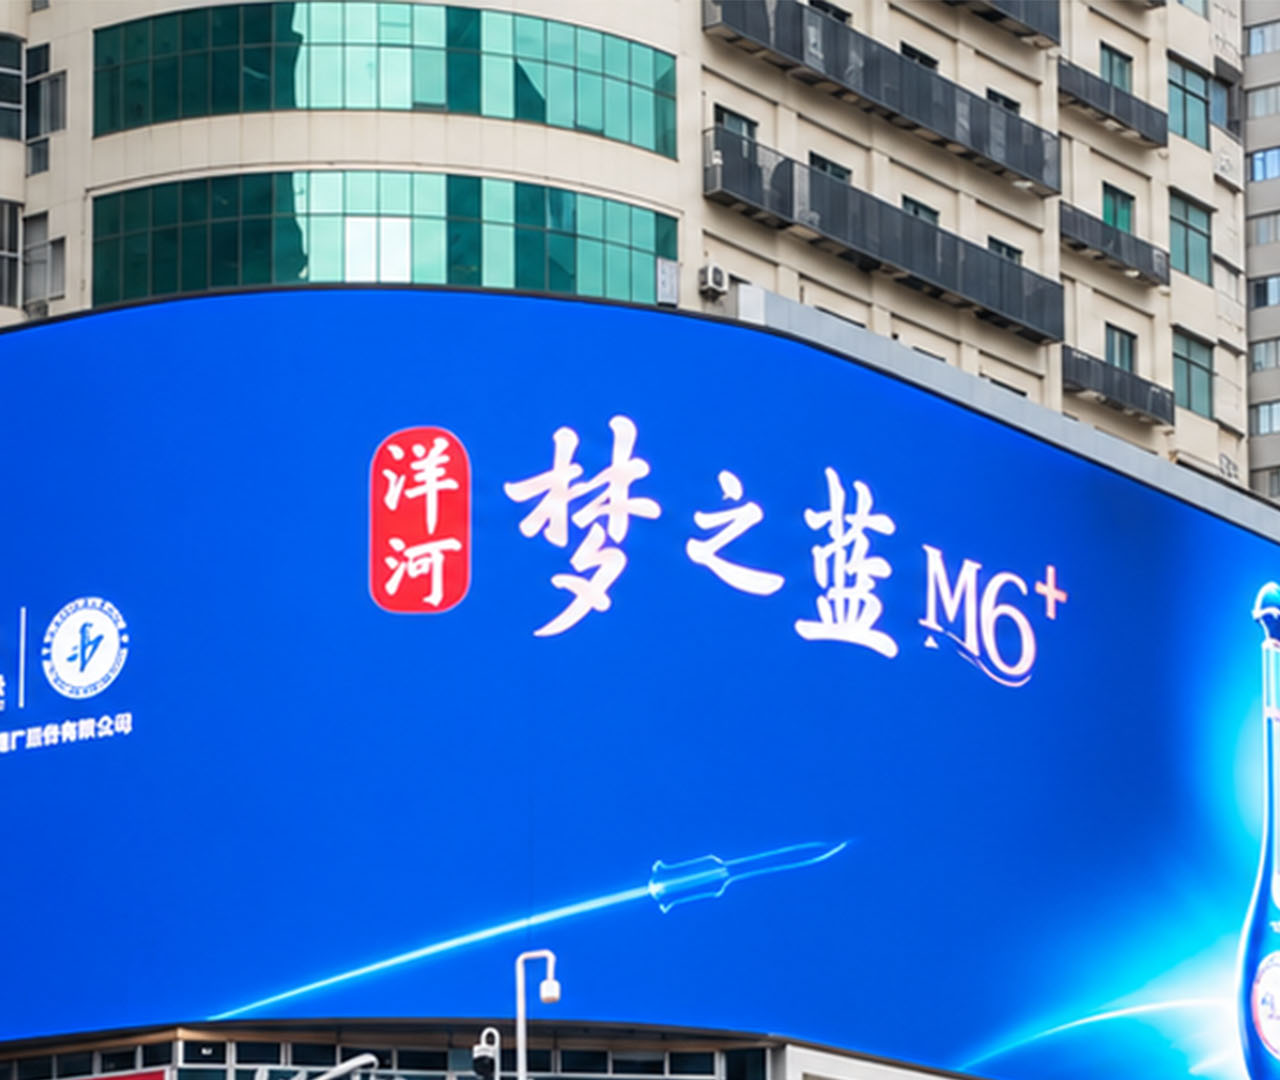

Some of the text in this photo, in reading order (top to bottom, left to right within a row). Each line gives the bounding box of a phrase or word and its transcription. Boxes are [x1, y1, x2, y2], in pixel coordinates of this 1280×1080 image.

[382, 437, 462, 606] 洋河
[503, 415, 899, 658] 梦之蓝
